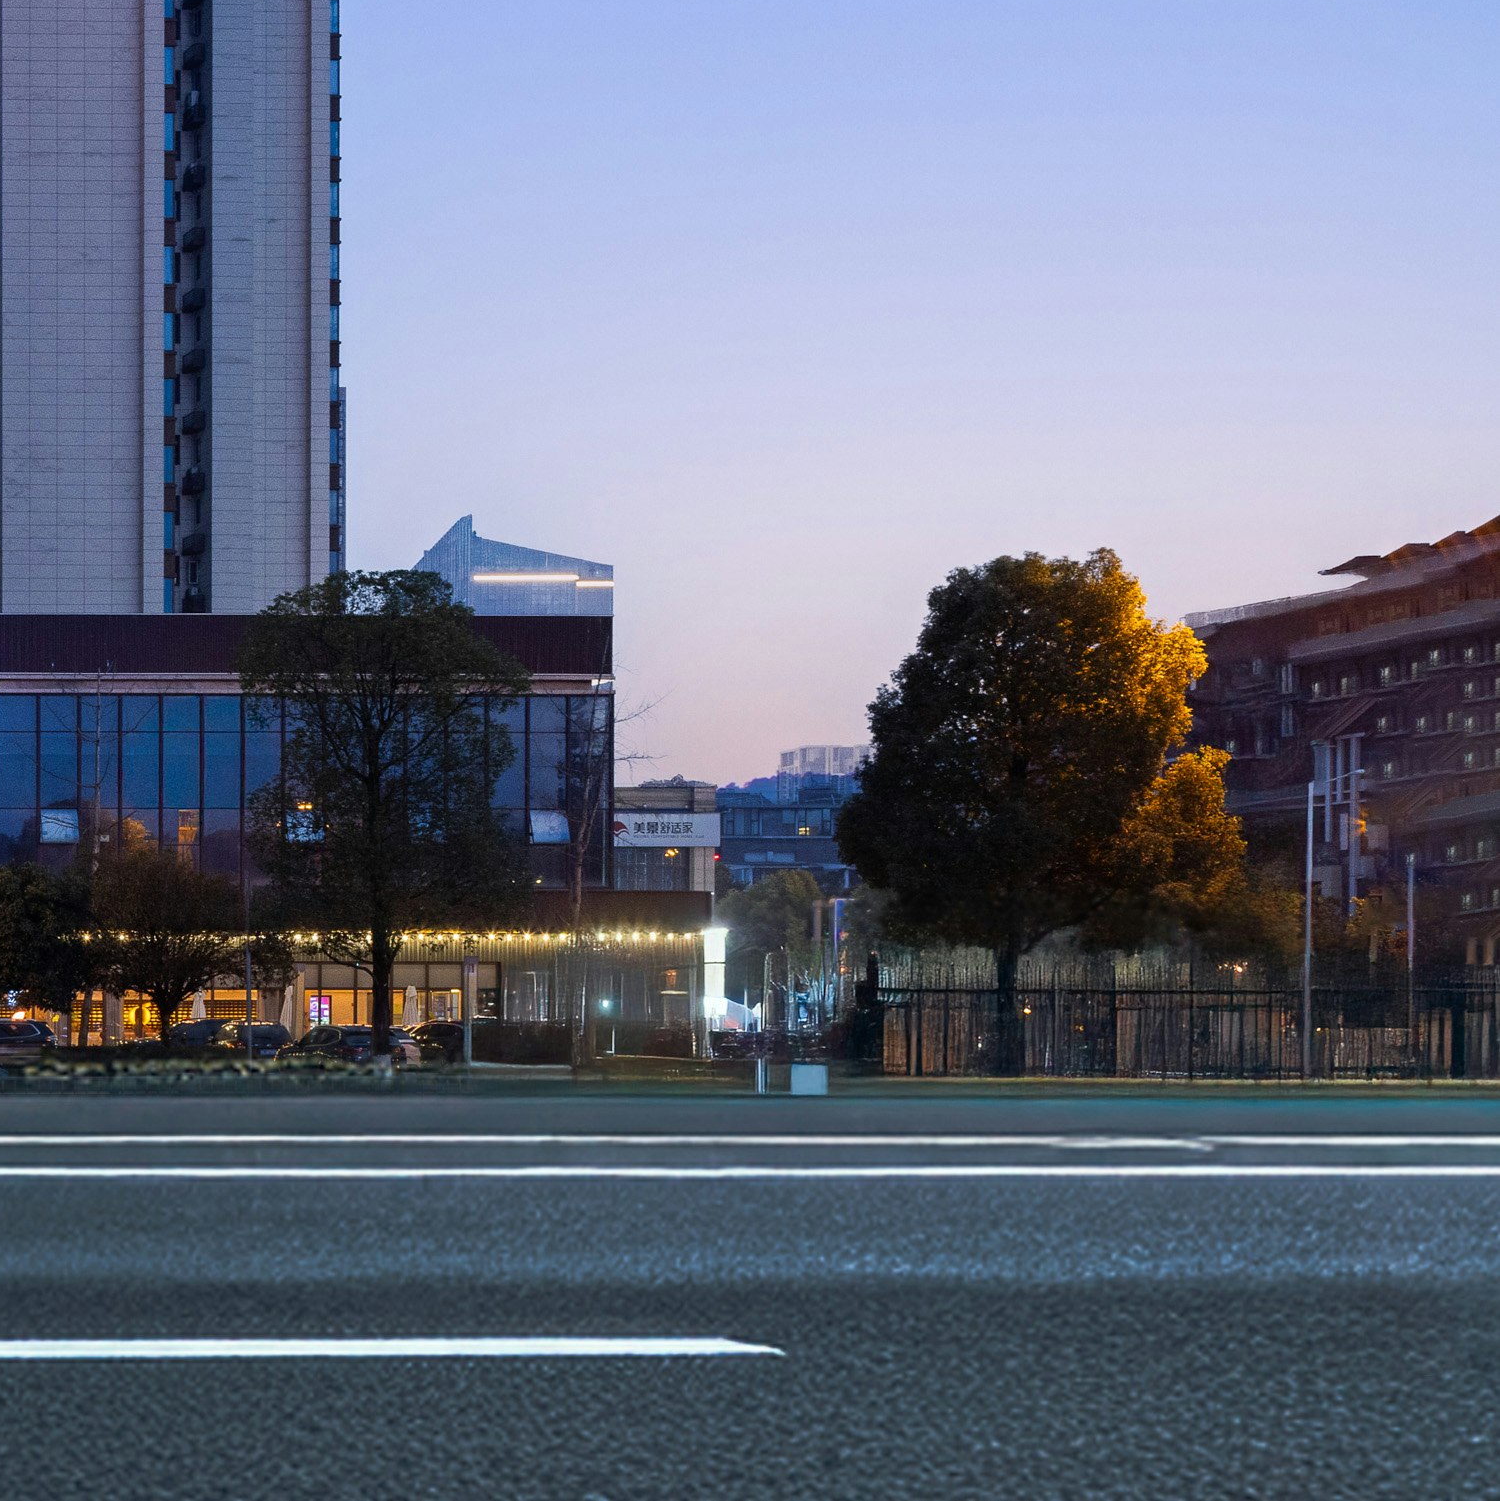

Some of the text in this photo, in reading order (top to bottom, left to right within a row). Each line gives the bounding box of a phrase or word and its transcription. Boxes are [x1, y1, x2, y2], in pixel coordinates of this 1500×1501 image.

[633, 821, 694, 834] 美景舒适家
